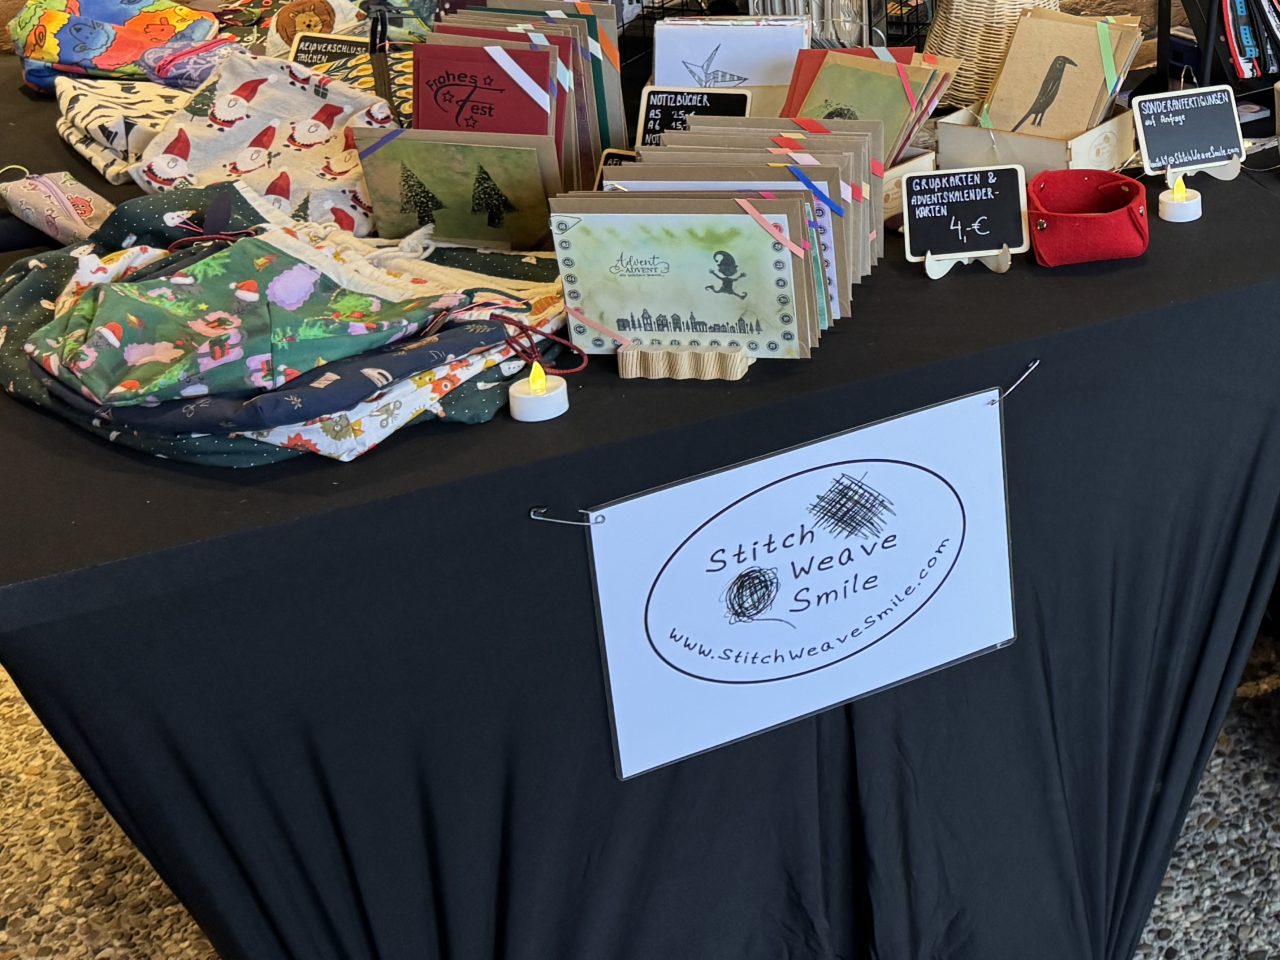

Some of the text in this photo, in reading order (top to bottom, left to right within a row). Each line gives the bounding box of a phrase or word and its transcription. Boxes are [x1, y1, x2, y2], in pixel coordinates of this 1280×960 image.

[425, 70, 478, 91] Frohes
[650, 93, 710, 107] NOTIZBÜCHER
[649, 109, 661, 119] A5
[1161, 113, 1186, 126] Anfrage
[648, 120, 660, 130] A6
[987, 171, 997, 184] &
[911, 188, 1000, 205] ADVENTSKALENDER-
[915, 205, 948, 219] KARTEN
[949, 216, 990, 243] 4,-€
[614, 251, 661, 268] Advent
[705, 522, 815, 574] Stitch
[790, 531, 898, 580] Weave
[789, 571, 879, 614] Smile
